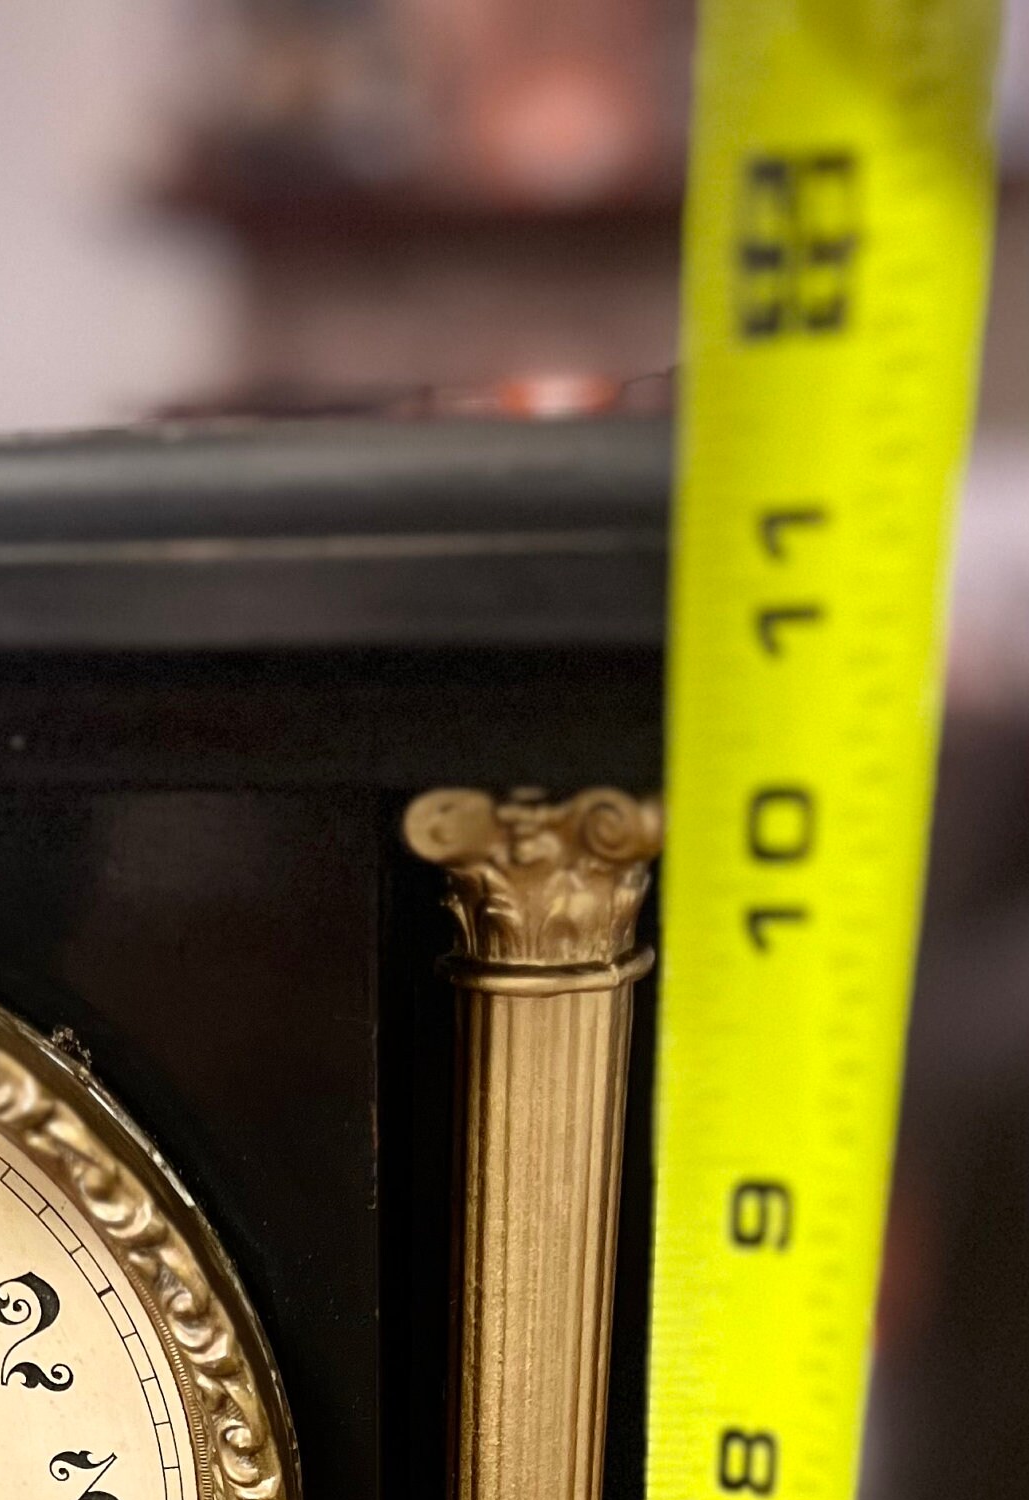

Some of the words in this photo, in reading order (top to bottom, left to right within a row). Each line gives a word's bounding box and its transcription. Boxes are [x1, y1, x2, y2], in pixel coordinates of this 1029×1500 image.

[756, 507, 829, 660] 11
[744, 783, 816, 952] 10
[731, 1179, 793, 1252] 9
[719, 1429, 776, 1497] 8
